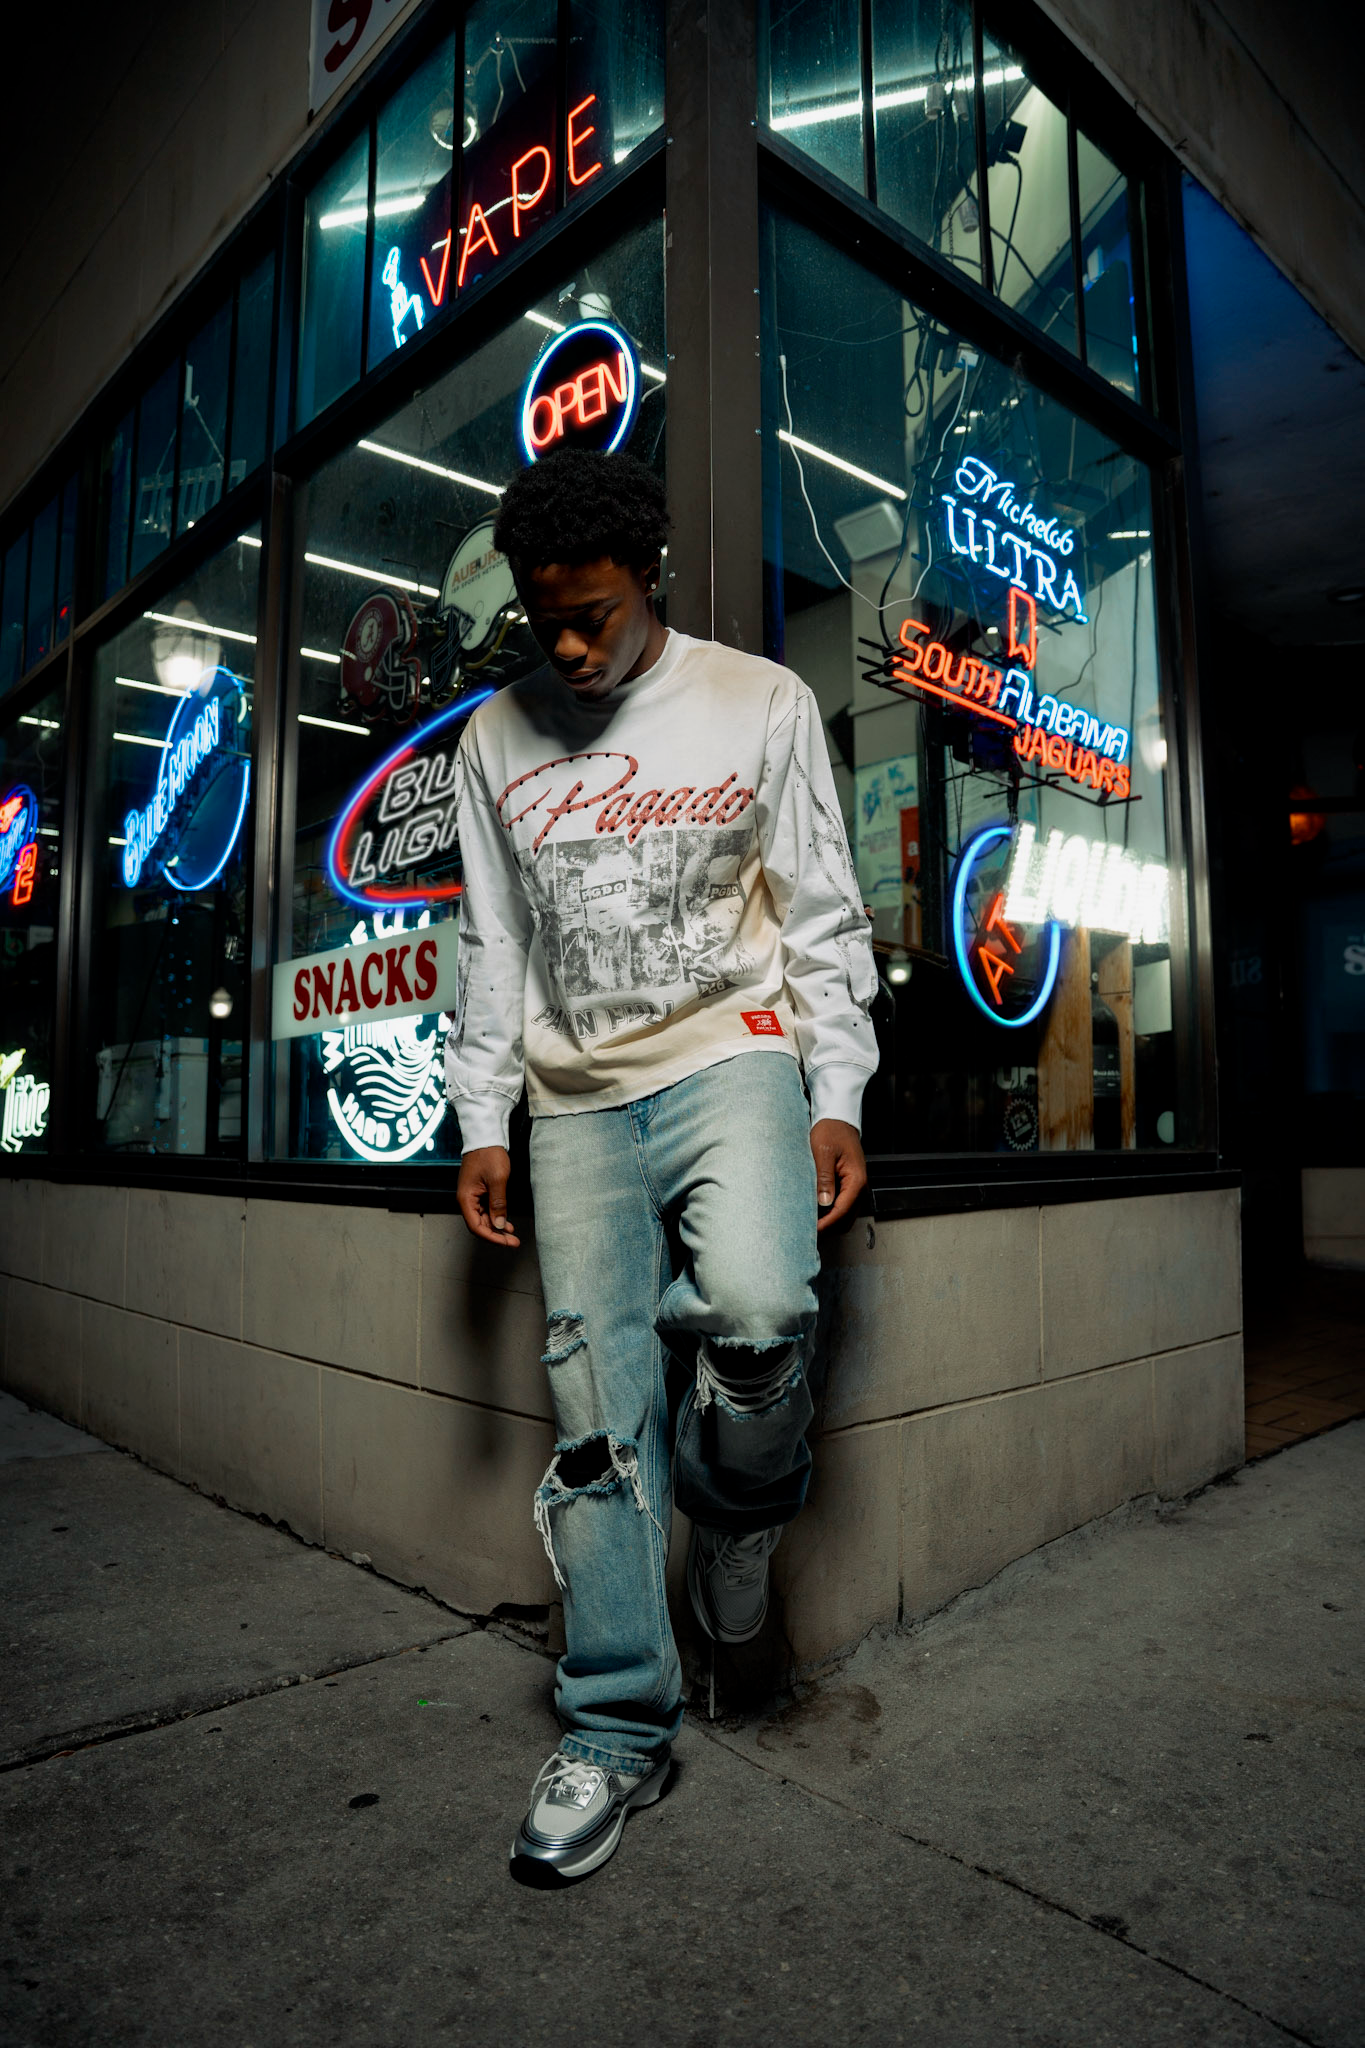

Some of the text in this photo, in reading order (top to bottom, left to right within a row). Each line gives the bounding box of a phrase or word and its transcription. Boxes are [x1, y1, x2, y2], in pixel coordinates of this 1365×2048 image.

[420, 94, 602, 306] VAPE
[527, 353, 628, 447] OPEN
[941, 494, 1089, 624] ULTRA
[892, 618, 1130, 763] SOUTH ALABAMA
[378, 753, 457, 824] BU
[496, 751, 755, 857] Pagado
[1012, 722, 1131, 799] JAGUARS
[348, 800, 459, 889] LIG
[293, 939, 438, 1021] SNACKS
[341, 1092, 391, 1148] HARD
